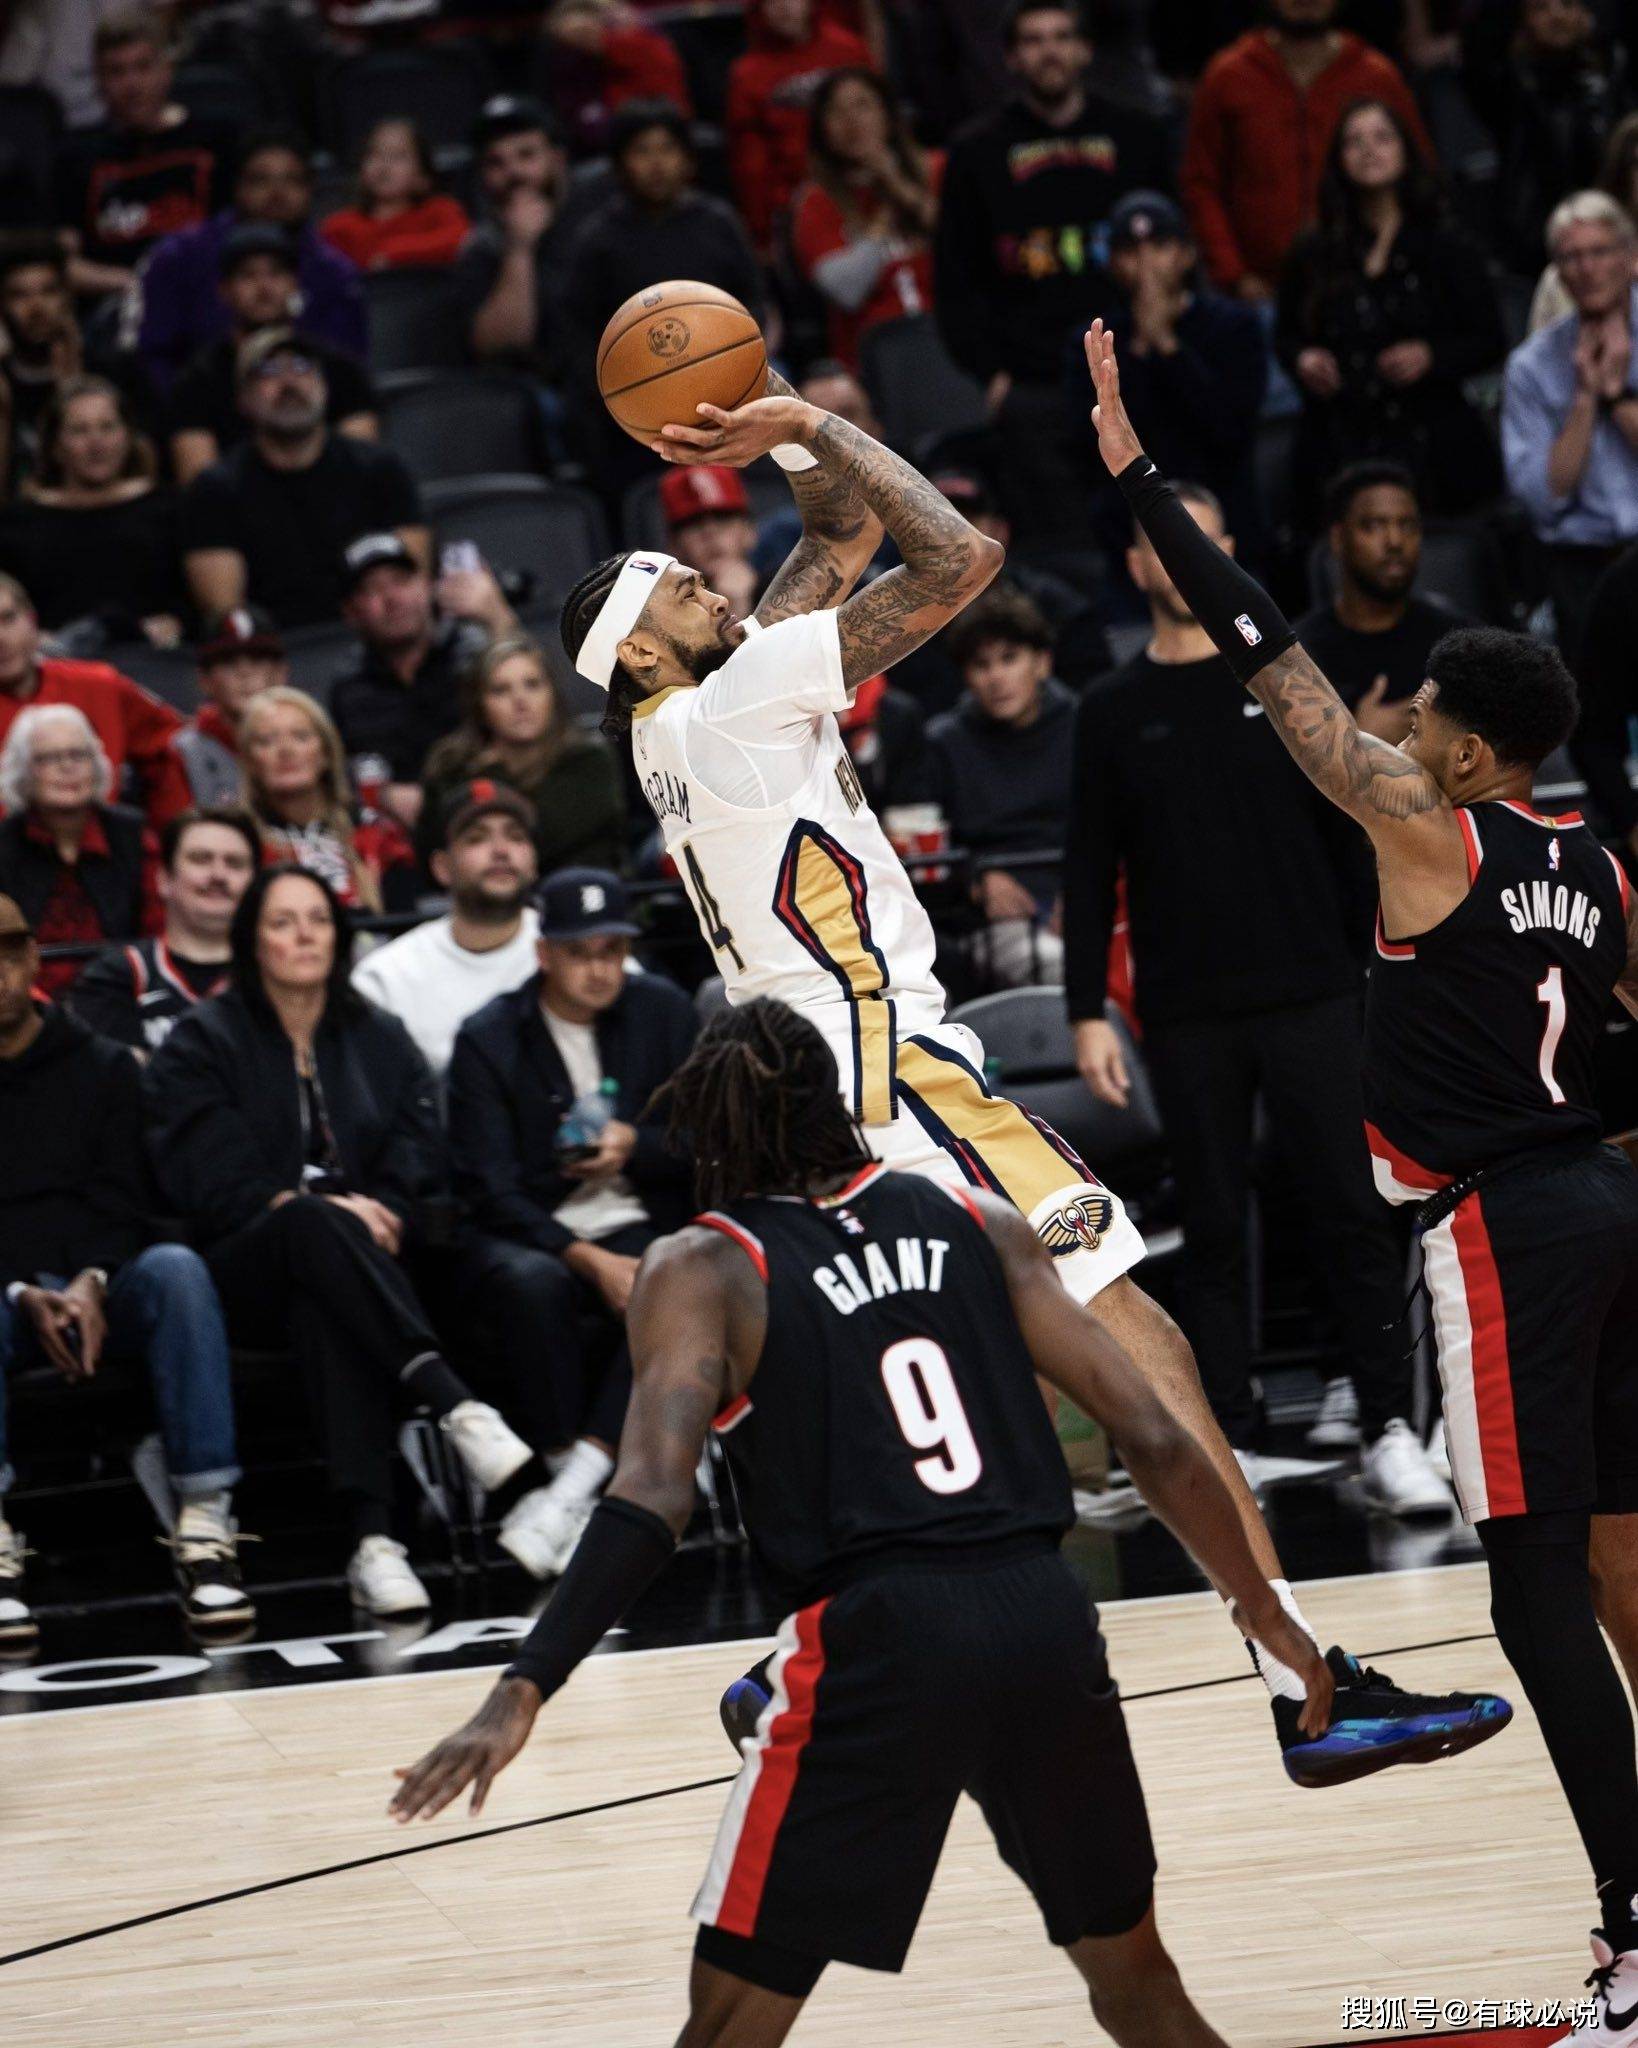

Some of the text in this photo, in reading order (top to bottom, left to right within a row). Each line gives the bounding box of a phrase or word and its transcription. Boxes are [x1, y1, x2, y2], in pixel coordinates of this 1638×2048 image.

[643, 769, 692, 825] GRAM
[682, 841, 747, 975] 4
[1500, 880, 1601, 949] SIMONS
[1535, 965, 1568, 1105] 1
[878, 1335, 984, 1496] 9
